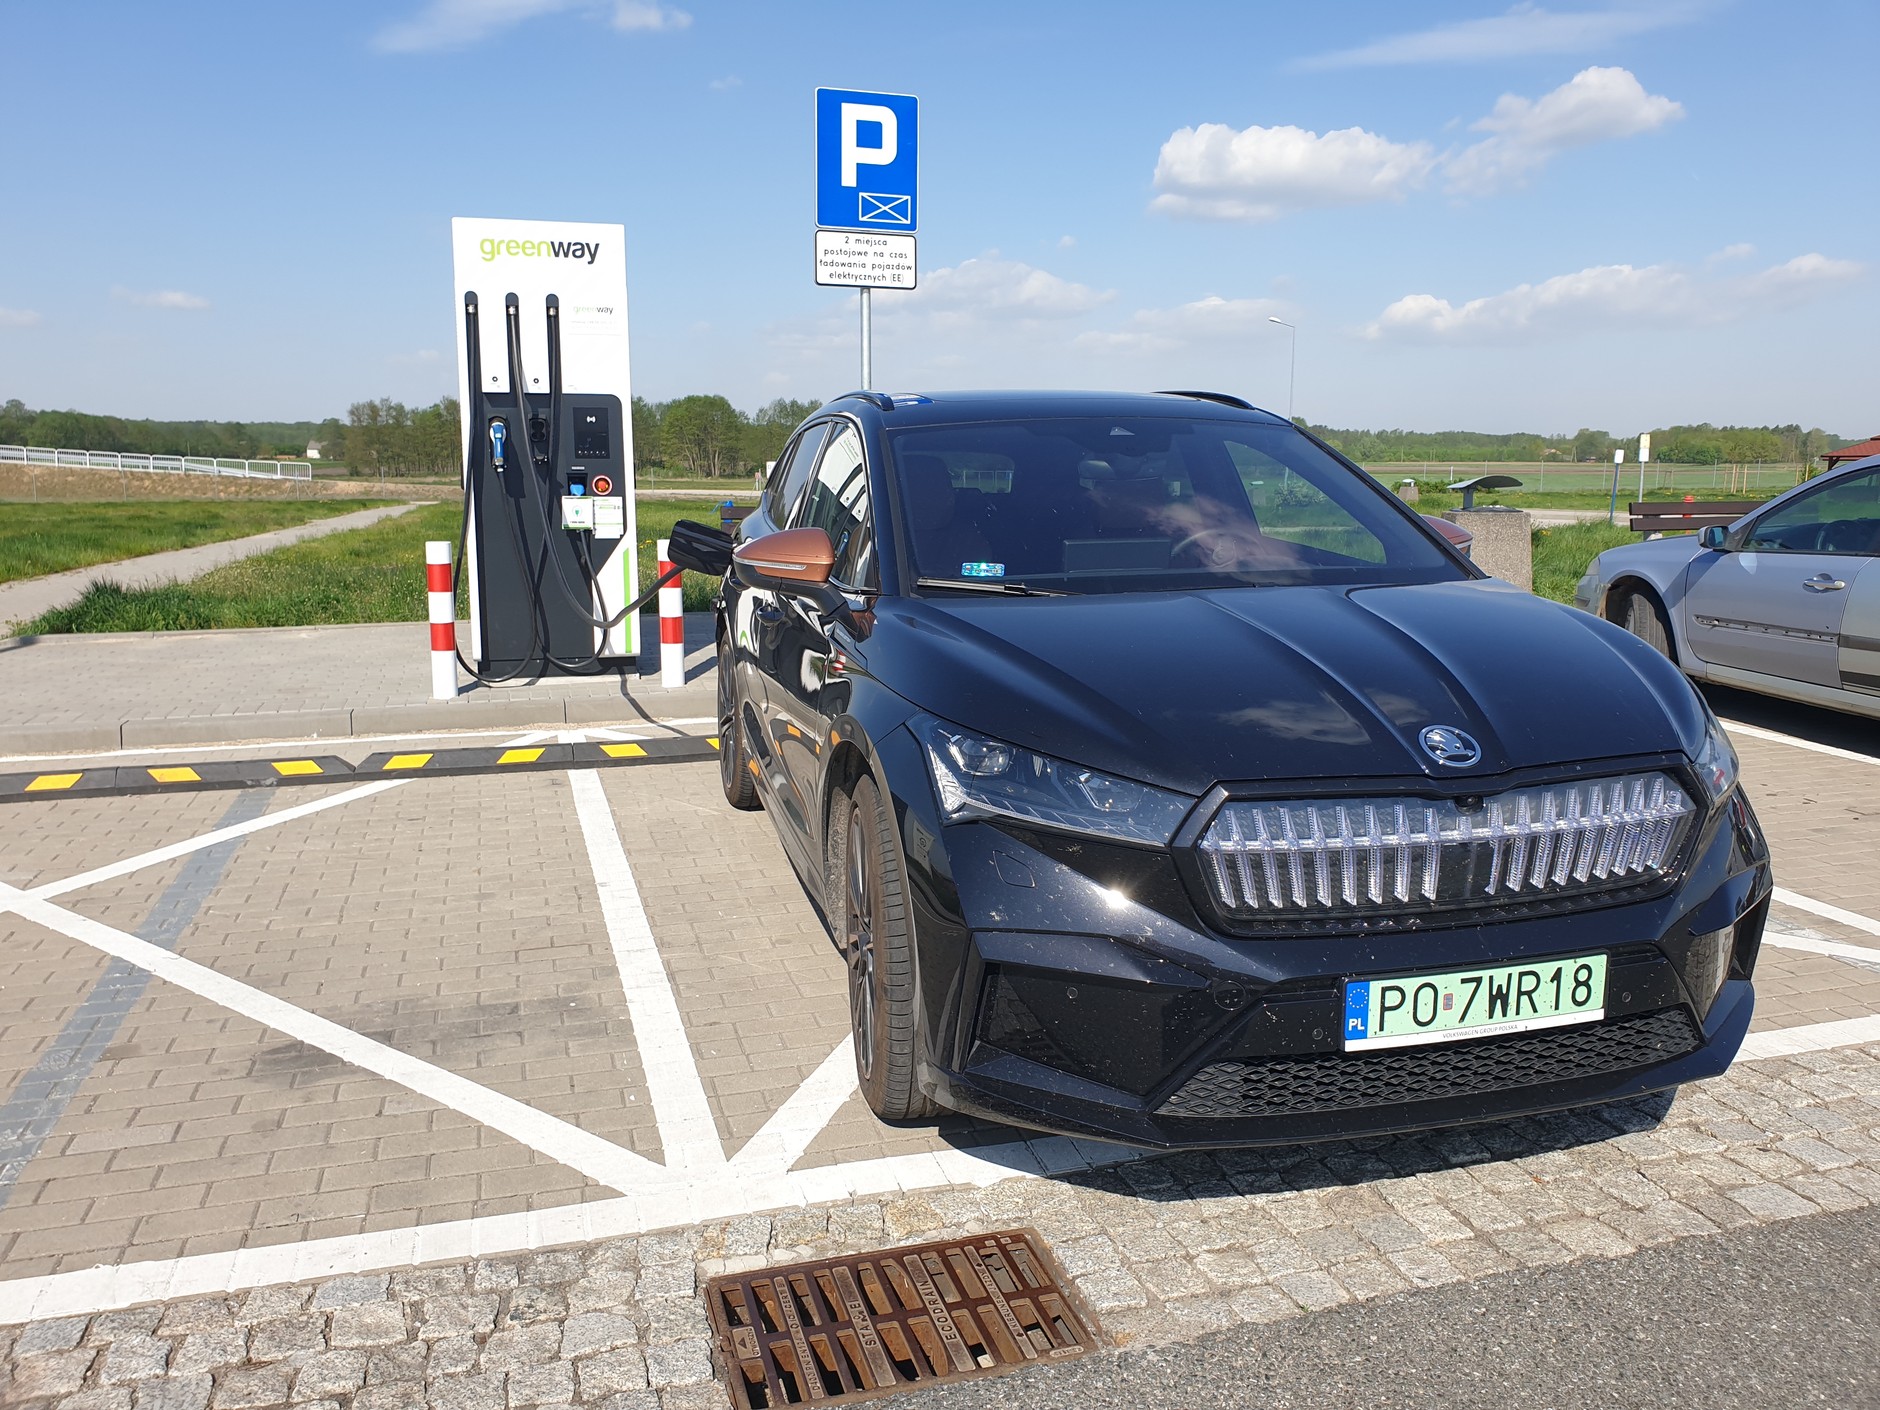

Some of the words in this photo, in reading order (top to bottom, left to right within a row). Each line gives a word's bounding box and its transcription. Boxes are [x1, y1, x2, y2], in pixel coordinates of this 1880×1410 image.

[840, 102, 898, 188] P
[844, 235, 850, 244] 2
[854, 236, 888, 247] miejsca
[479, 238, 600, 265] greenway
[823, 248, 869, 258] postojowe
[873, 250, 885, 258] na
[828, 270, 887, 283] elektrycznych
[1348, 1017, 1365, 1031] PL
[1442, 1029, 1479, 1039] VOLKSWAGEN
[1479, 1026, 1498, 1035] GROUP
[1498, 1024, 1518, 1032] POLSKA
[917, 1279, 957, 1341] ECODRAIN
